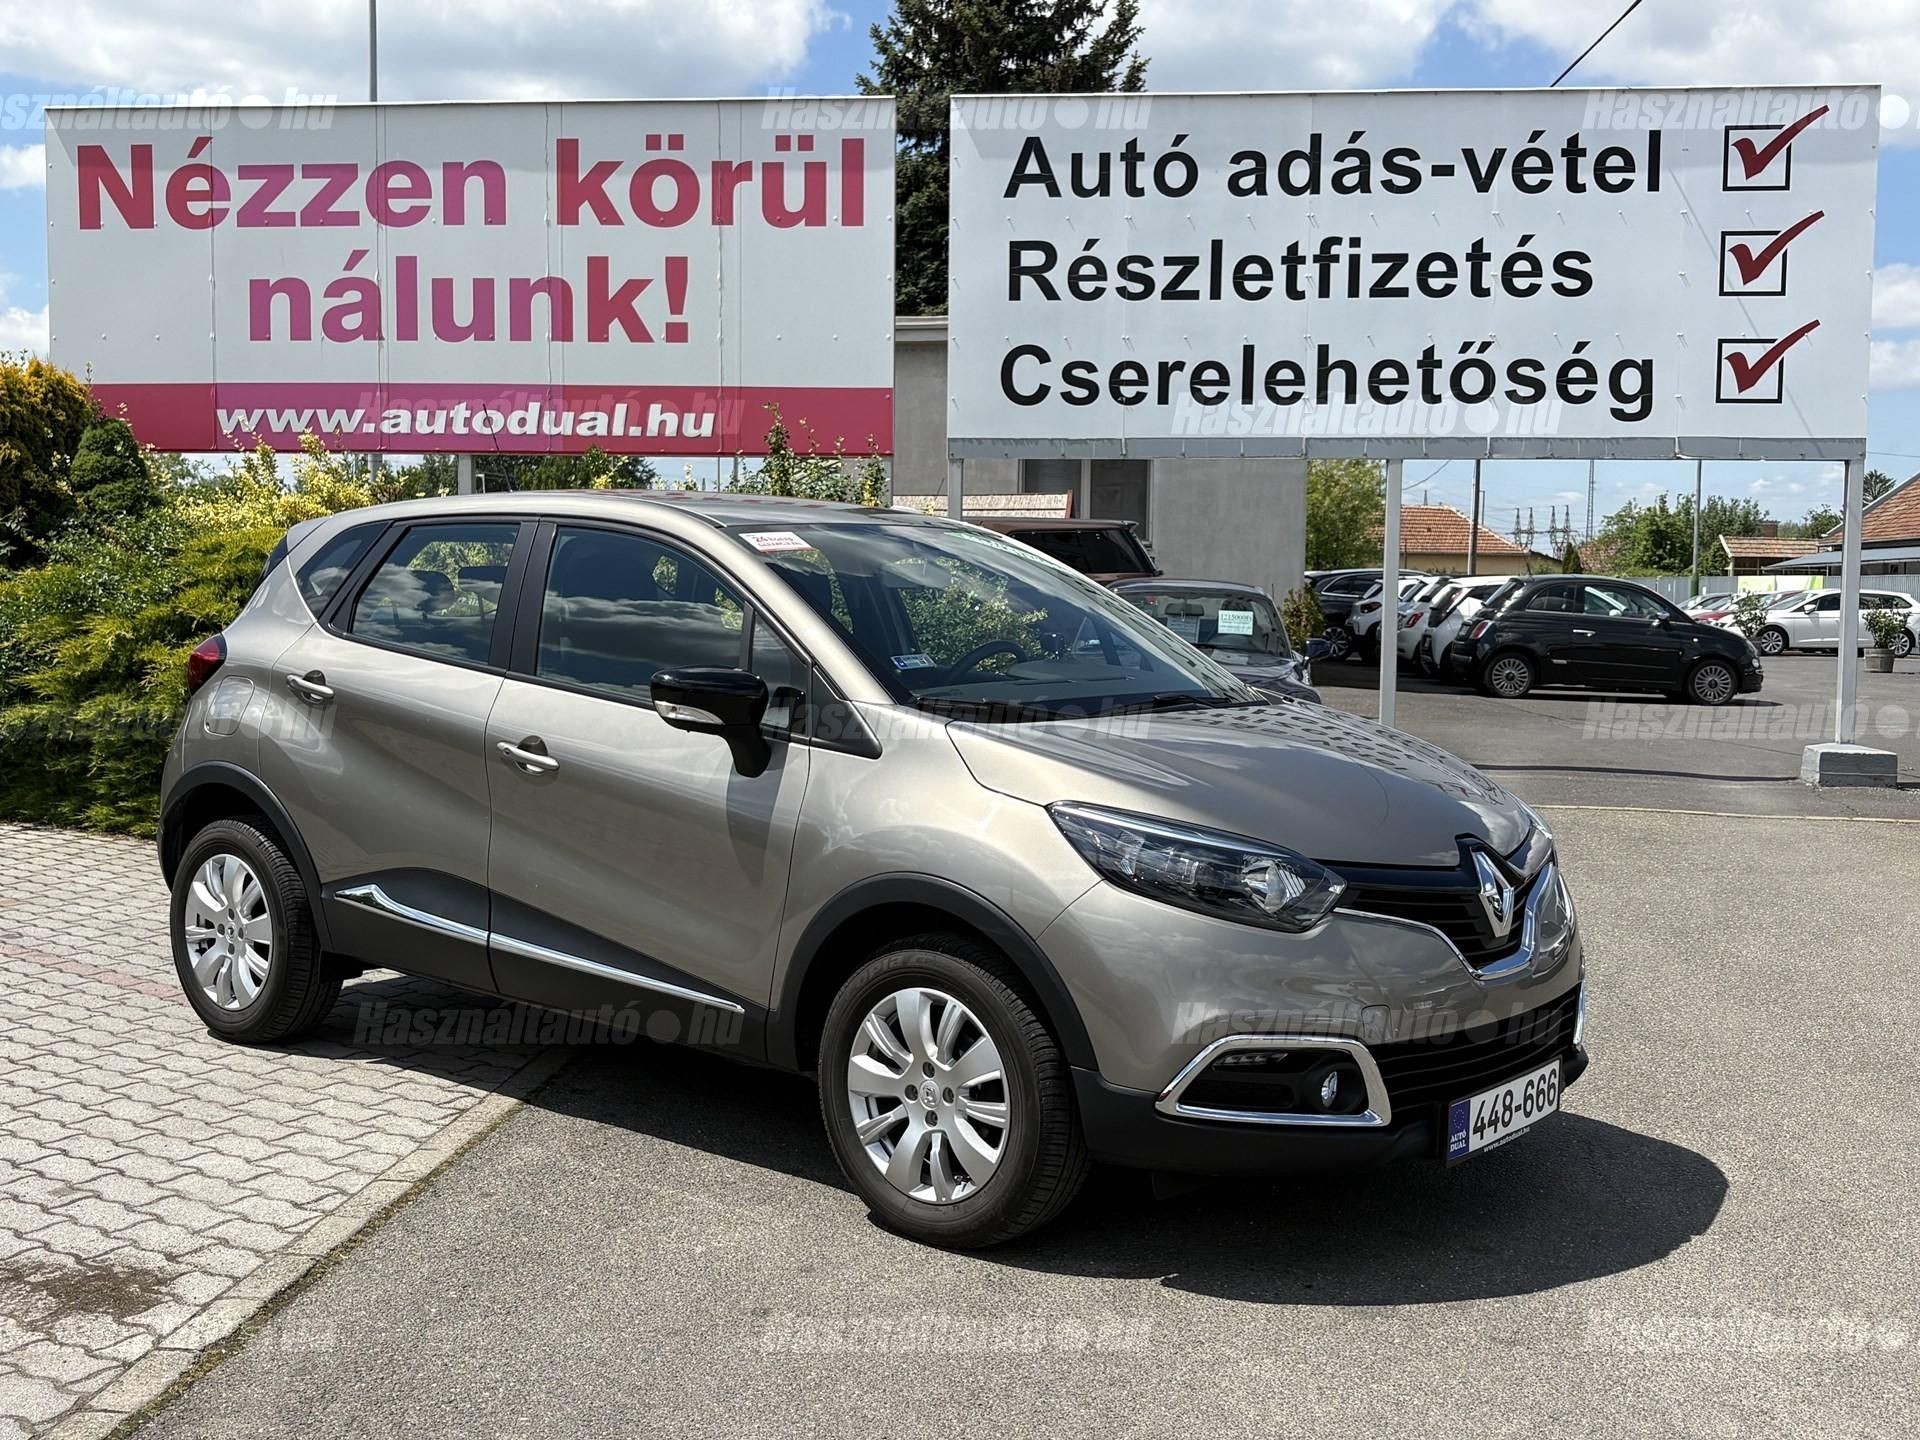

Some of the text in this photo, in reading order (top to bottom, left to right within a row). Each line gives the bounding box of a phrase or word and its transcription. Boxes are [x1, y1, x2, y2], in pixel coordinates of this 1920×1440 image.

[77, 135, 865, 230] Nézzen körül
[1003, 130, 1662, 199] Autó adás-vétel
[249, 250, 689, 343] nálunk!
[1008, 234, 1593, 302] Részletfizetés
[1000, 340, 1653, 422] Cserelehetőség
[216, 401, 715, 438] www.autodual.hu
[1449, 1129, 1467, 1143] AUTÓ
[1472, 1067, 1557, 1142] 448-666
[1449, 1140, 1467, 1153] DUAL
